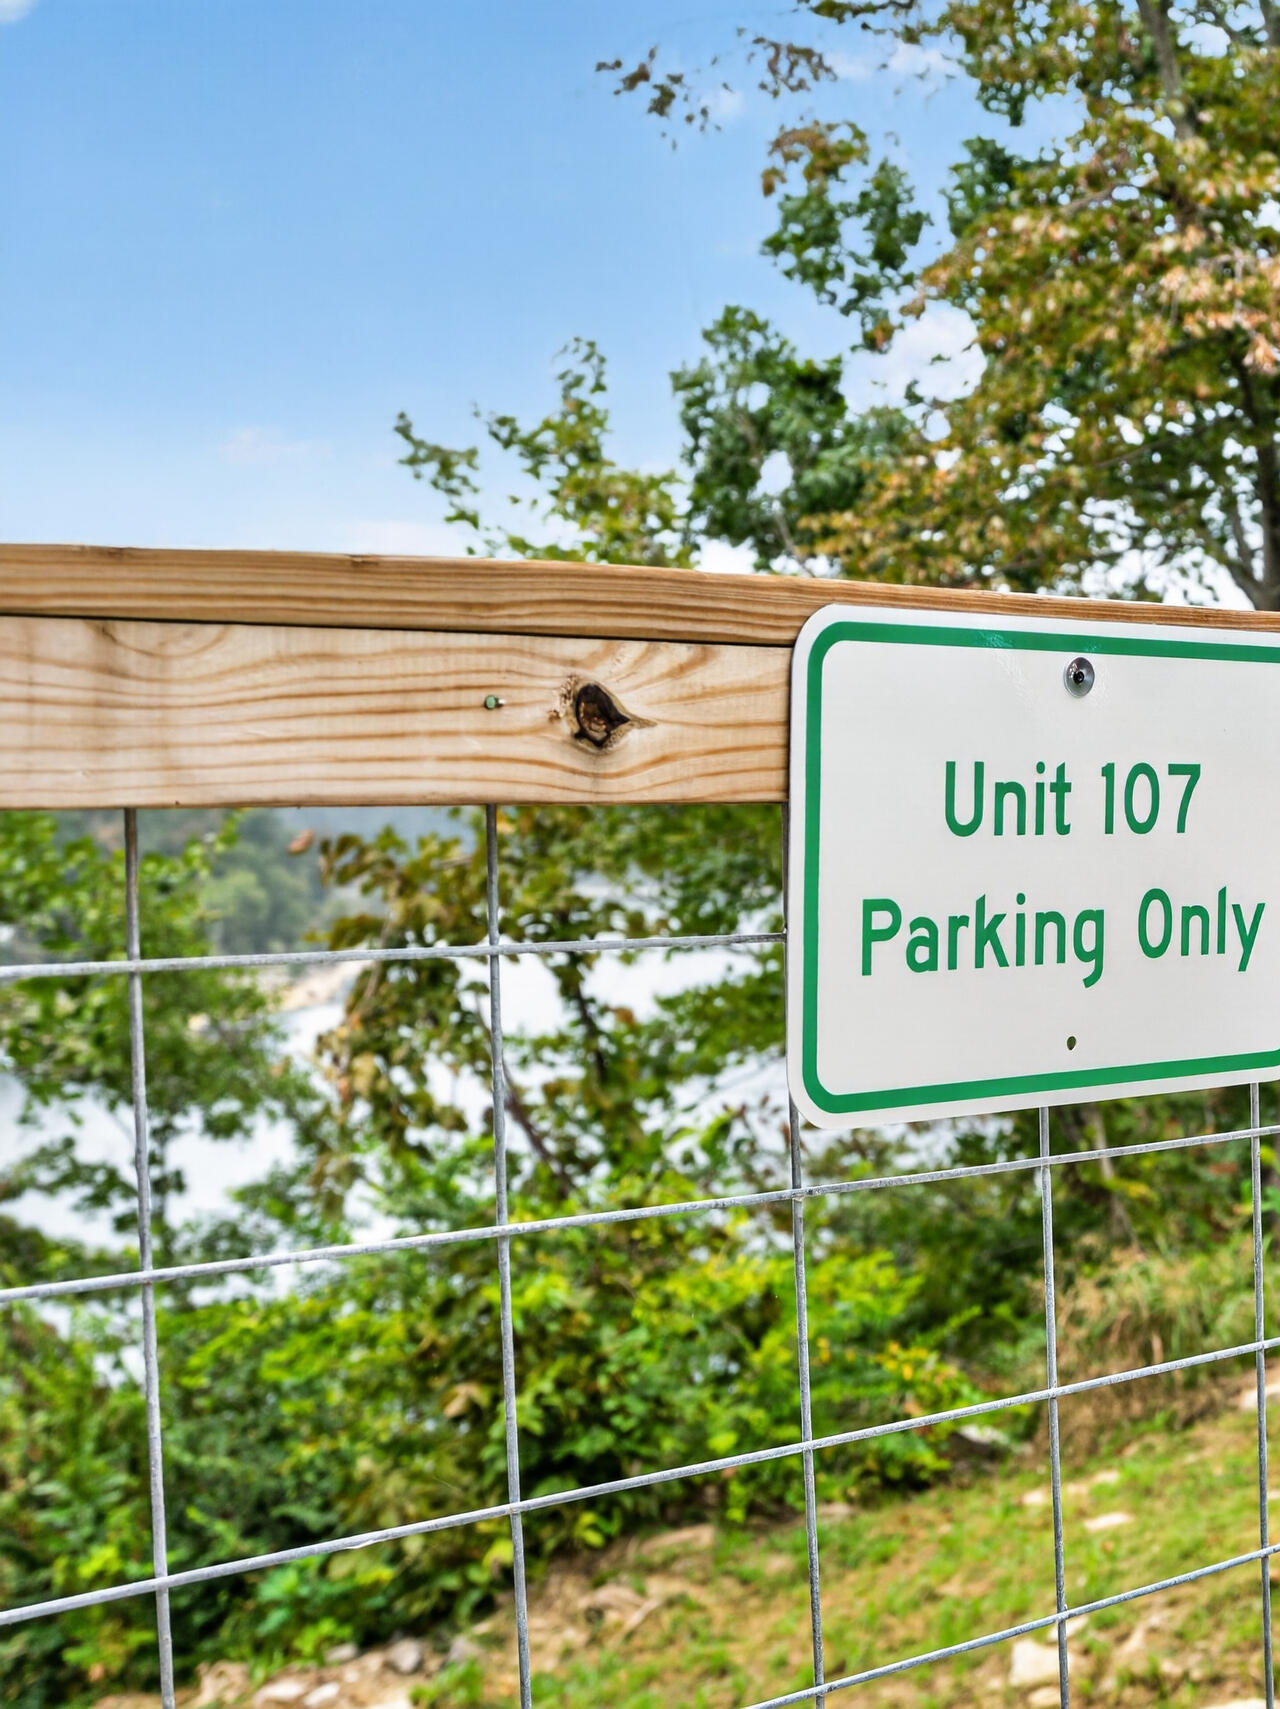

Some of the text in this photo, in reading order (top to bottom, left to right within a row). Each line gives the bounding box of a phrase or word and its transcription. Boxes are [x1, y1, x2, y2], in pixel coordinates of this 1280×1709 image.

[945, 761, 1201, 837] Unit 107
[861, 886, 1266, 989] Parking Only
